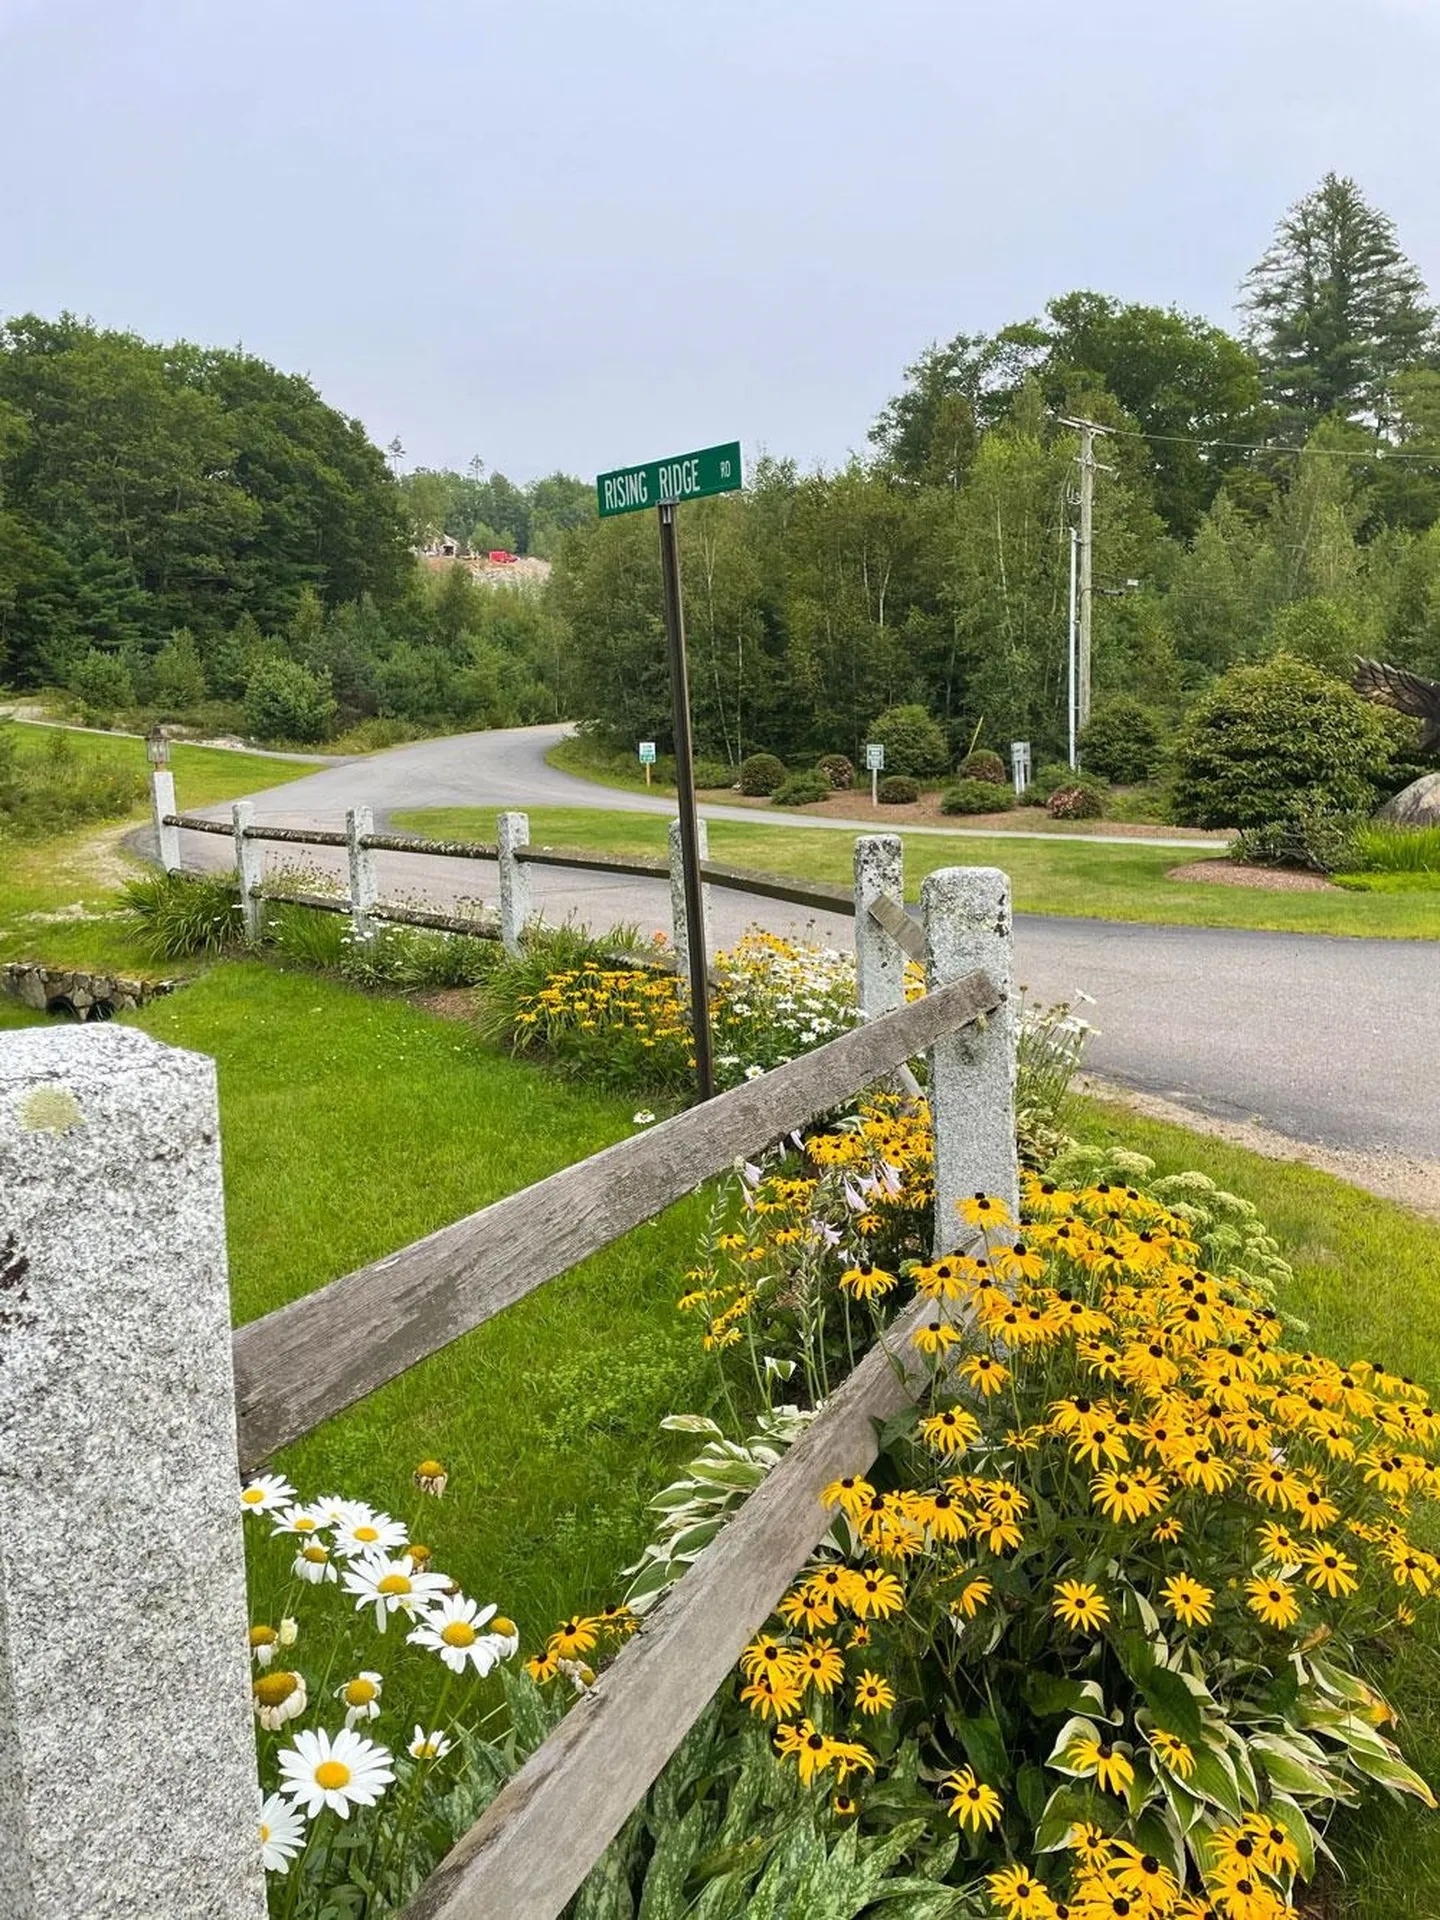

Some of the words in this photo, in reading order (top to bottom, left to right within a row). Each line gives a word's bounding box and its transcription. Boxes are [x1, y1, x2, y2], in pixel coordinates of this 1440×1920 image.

[605, 471, 648, 509] RISING
[659, 459, 700, 498] RIDGE
[719, 460, 731, 479] RD
